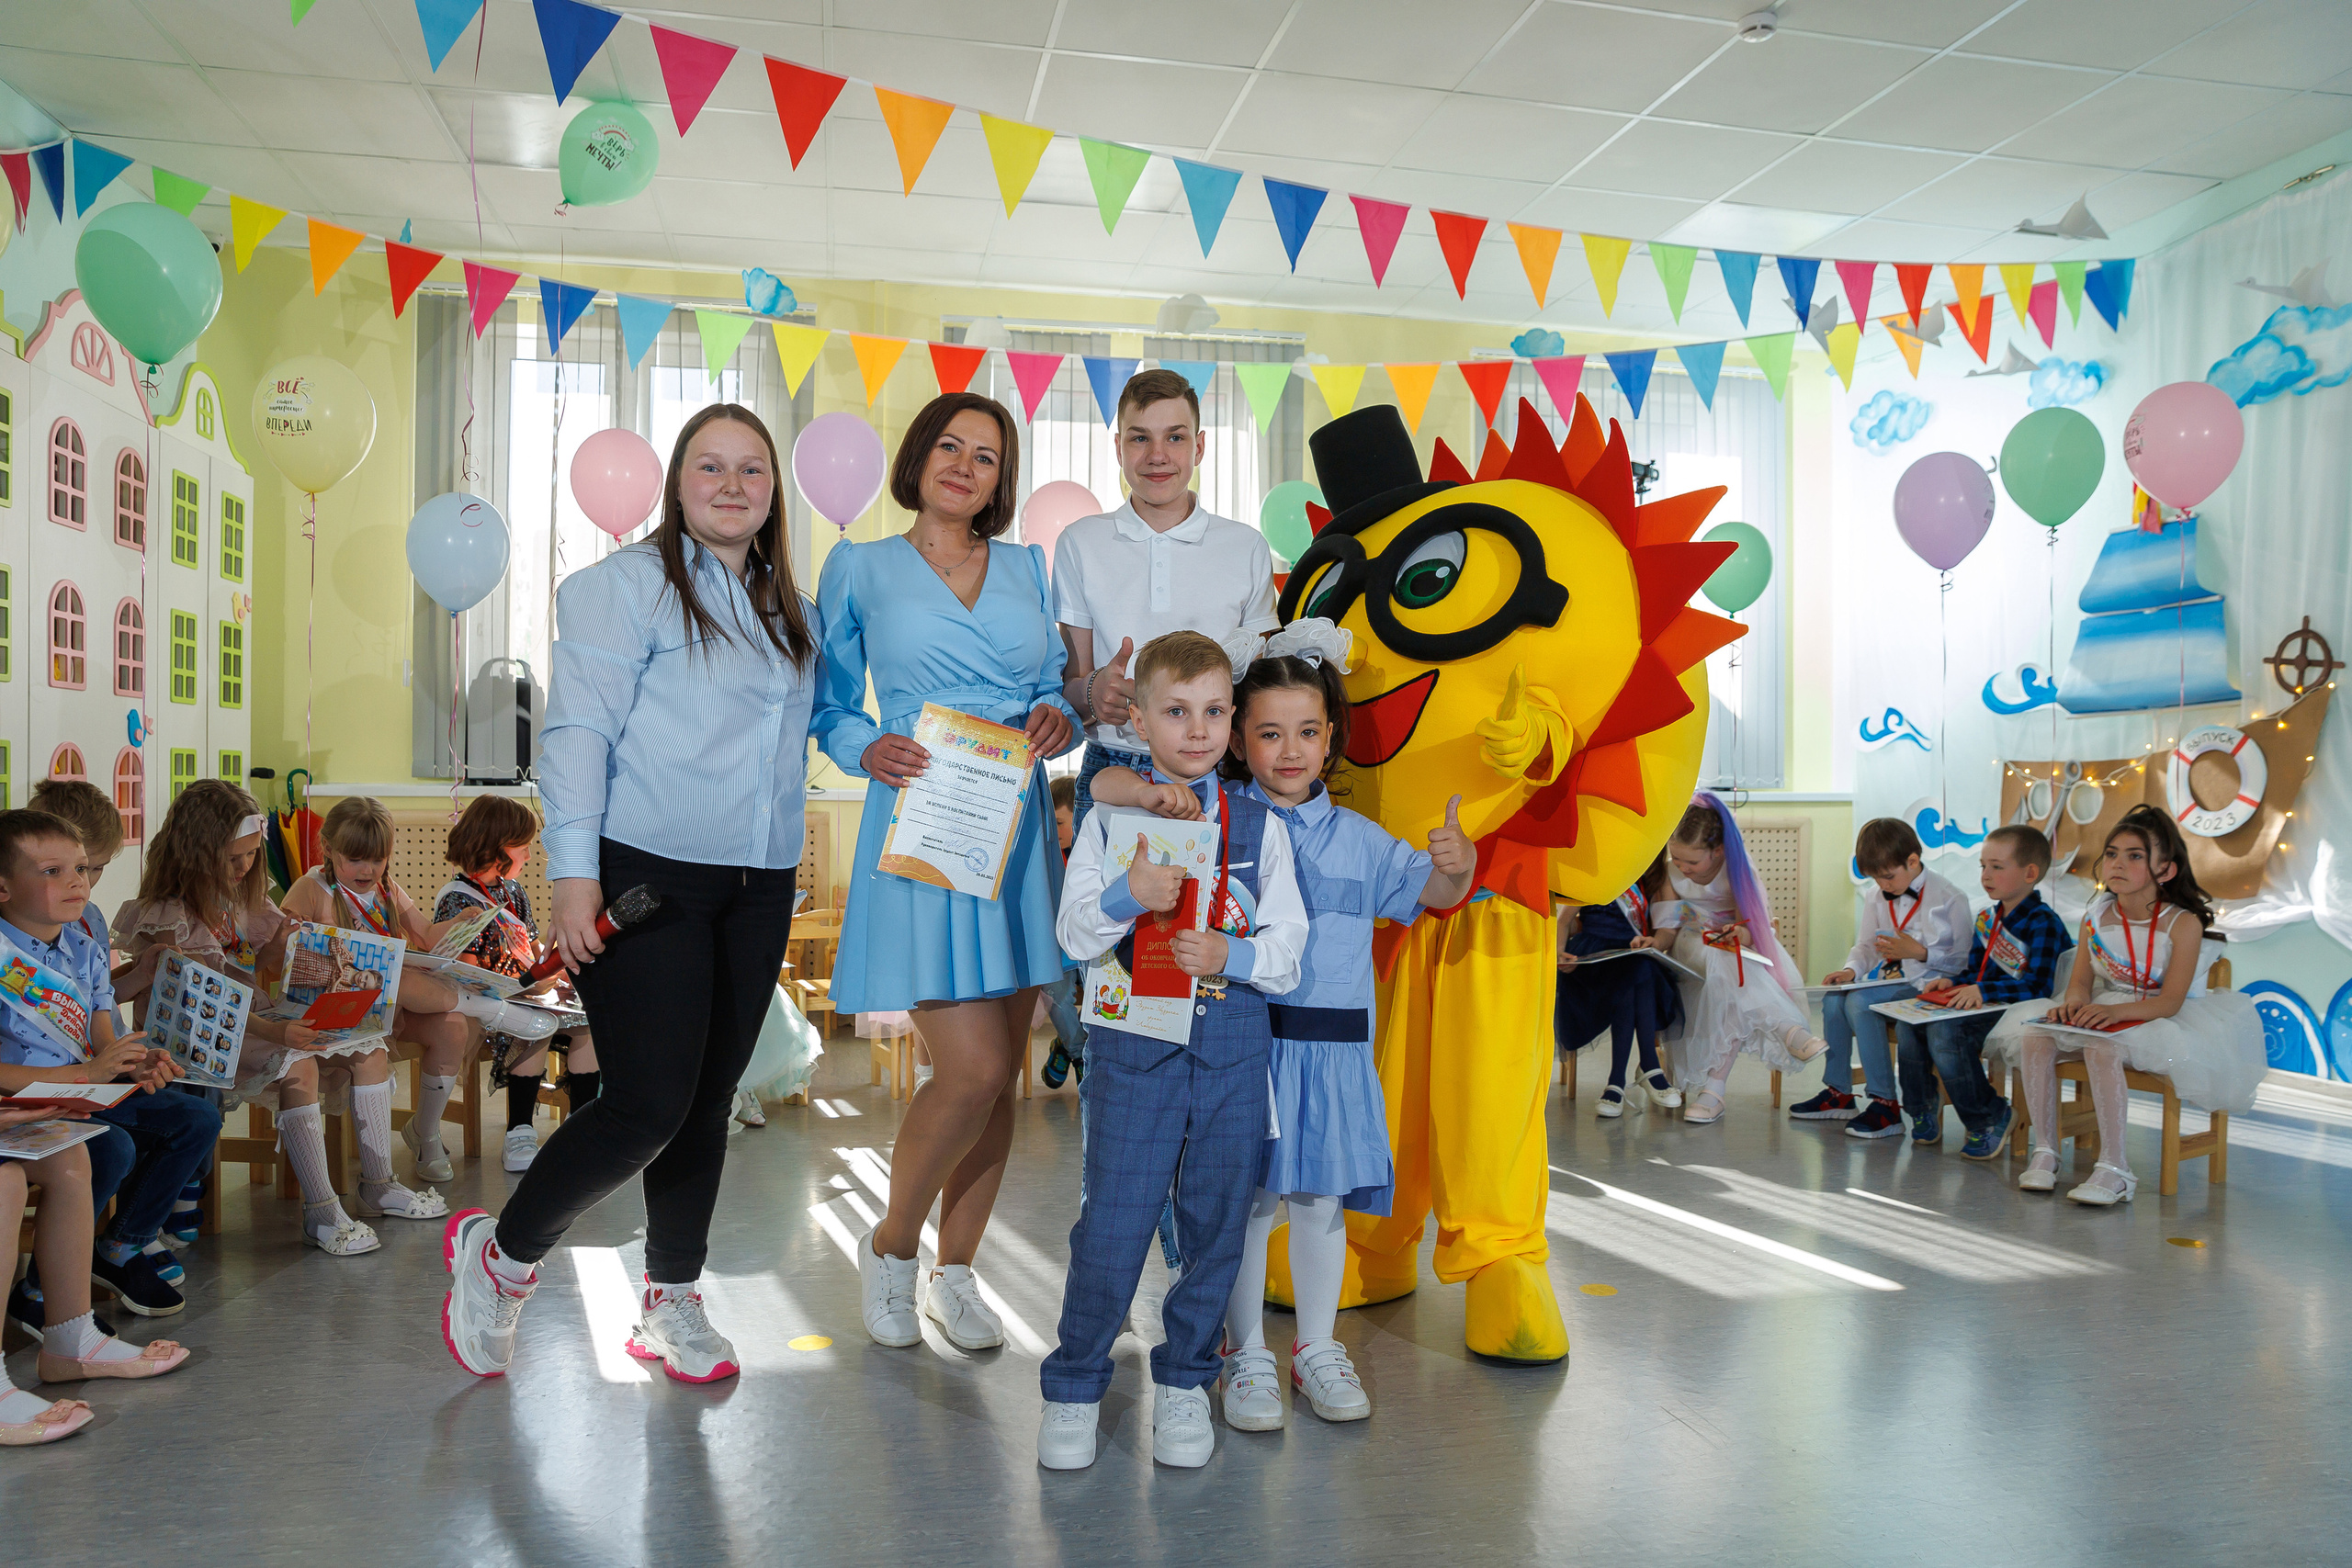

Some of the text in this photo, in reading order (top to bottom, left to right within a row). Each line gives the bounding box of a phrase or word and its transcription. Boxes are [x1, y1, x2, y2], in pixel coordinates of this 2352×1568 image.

[606, 137, 627, 157] ВЕРЬ
[277, 377, 304, 395] ВСЁ
[266, 416, 313, 433] ВПЕРЕДИ
[943, 732, 1012, 761] ЭРУДИТ
[2185, 731, 2236, 752] ВЫПУСК
[929, 755, 1017, 786] ЛАГОДАРСТВЕННОЕ ПИСЬМО
[2192, 812, 2236, 830] 2023
[1147, 942, 1173, 952] ДИПЛО
[1200, 974, 1224, 984] 2023
[1237, 1379, 1255, 1389] GIRL
